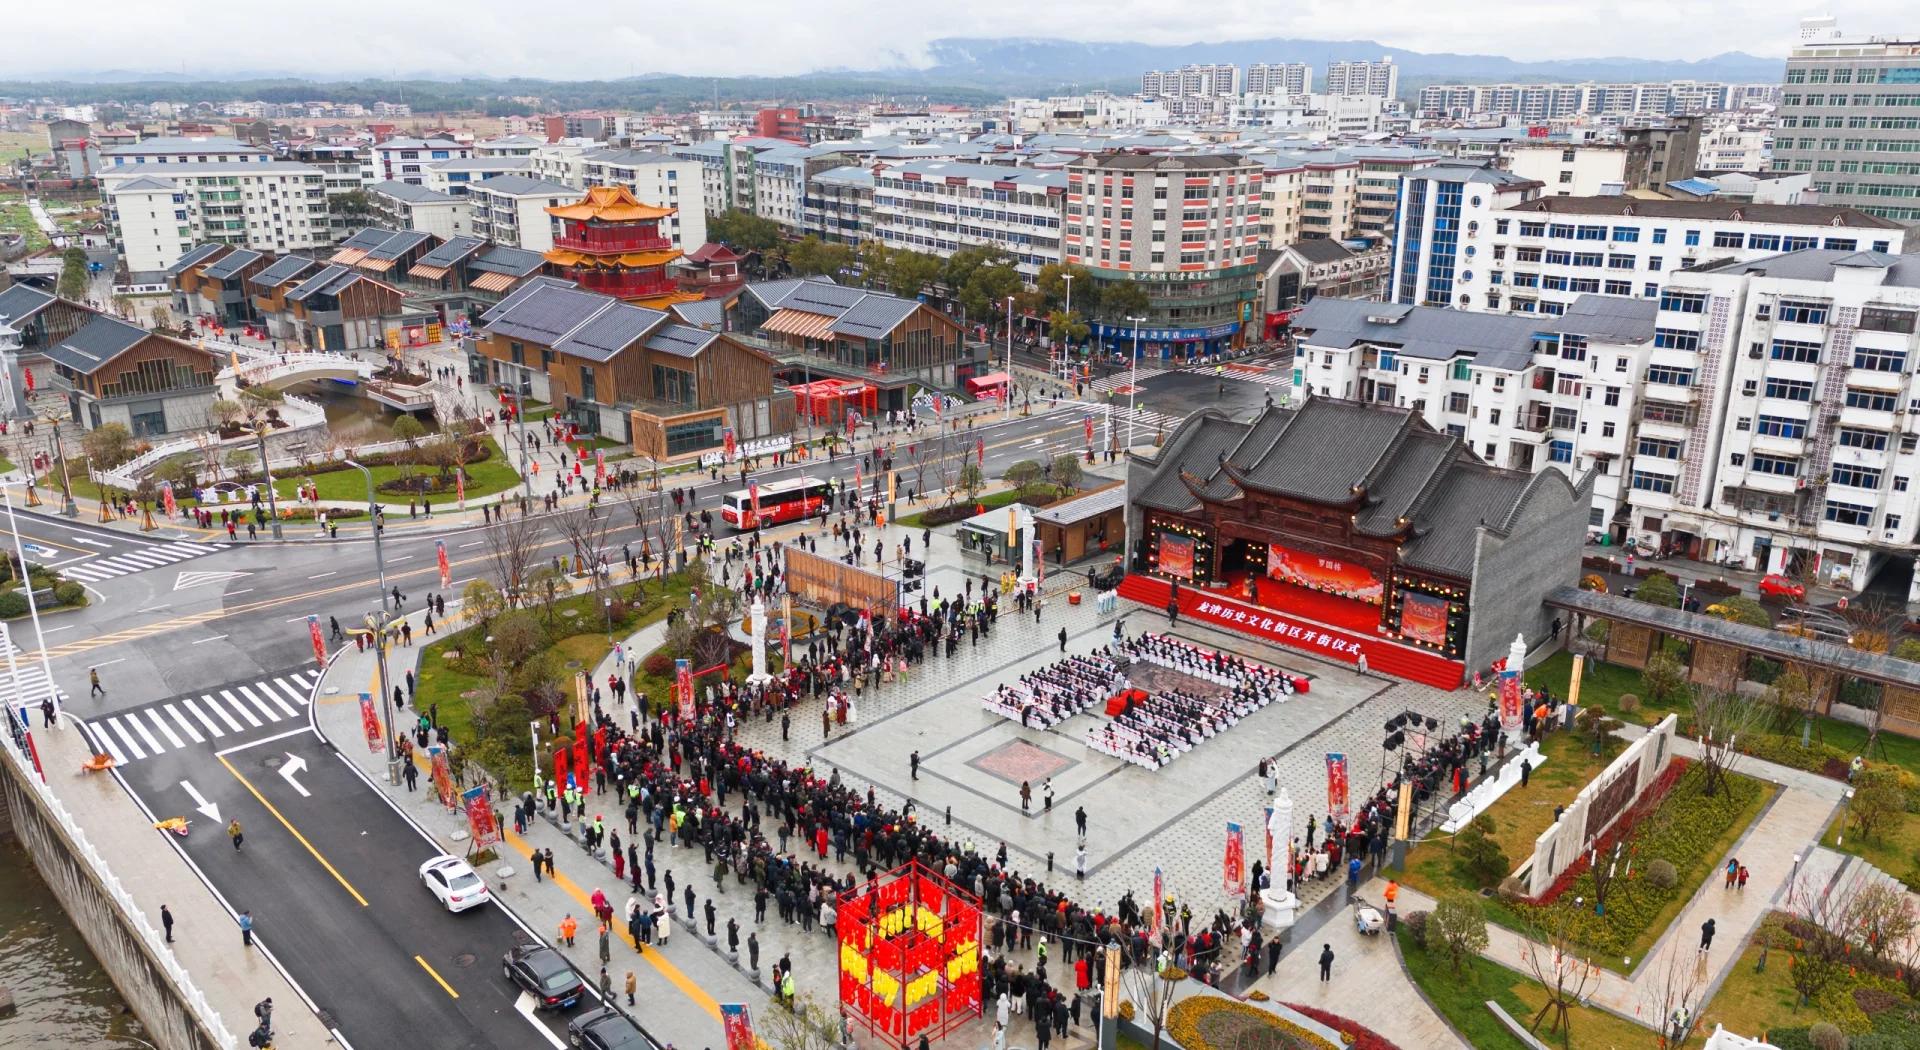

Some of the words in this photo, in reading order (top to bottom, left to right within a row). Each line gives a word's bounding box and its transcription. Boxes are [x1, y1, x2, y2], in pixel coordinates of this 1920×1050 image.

[1195, 600, 1362, 656] 龙津历史文化街区开街仪式
